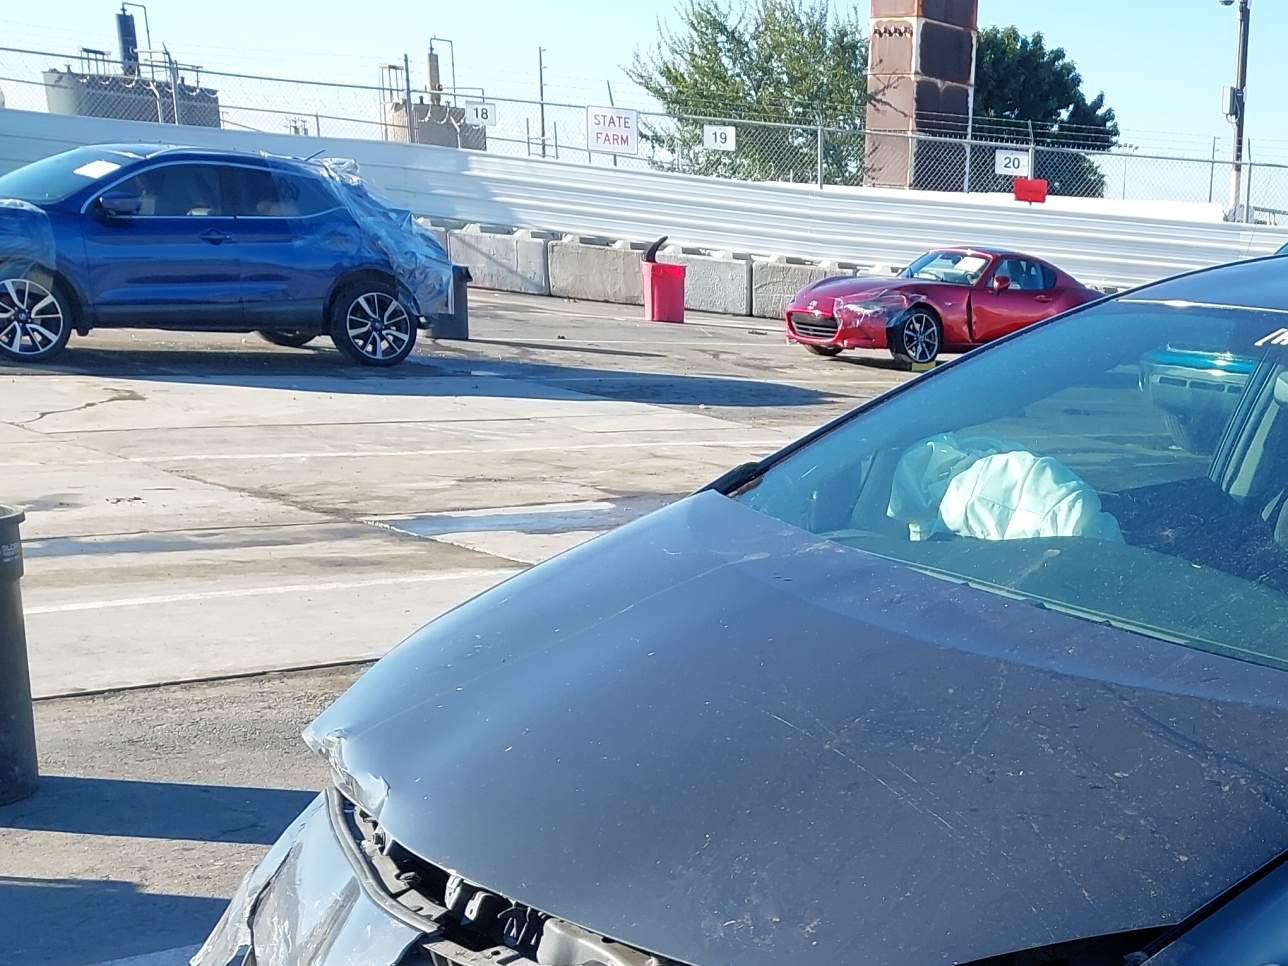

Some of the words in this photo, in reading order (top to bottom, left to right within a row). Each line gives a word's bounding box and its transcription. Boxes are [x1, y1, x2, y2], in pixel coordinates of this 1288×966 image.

[473, 107, 489, 120] 18
[593, 115, 631, 129] STATE
[595, 132, 630, 146] FARM
[711, 131, 728, 144] 19
[1003, 156, 1021, 169] 20
